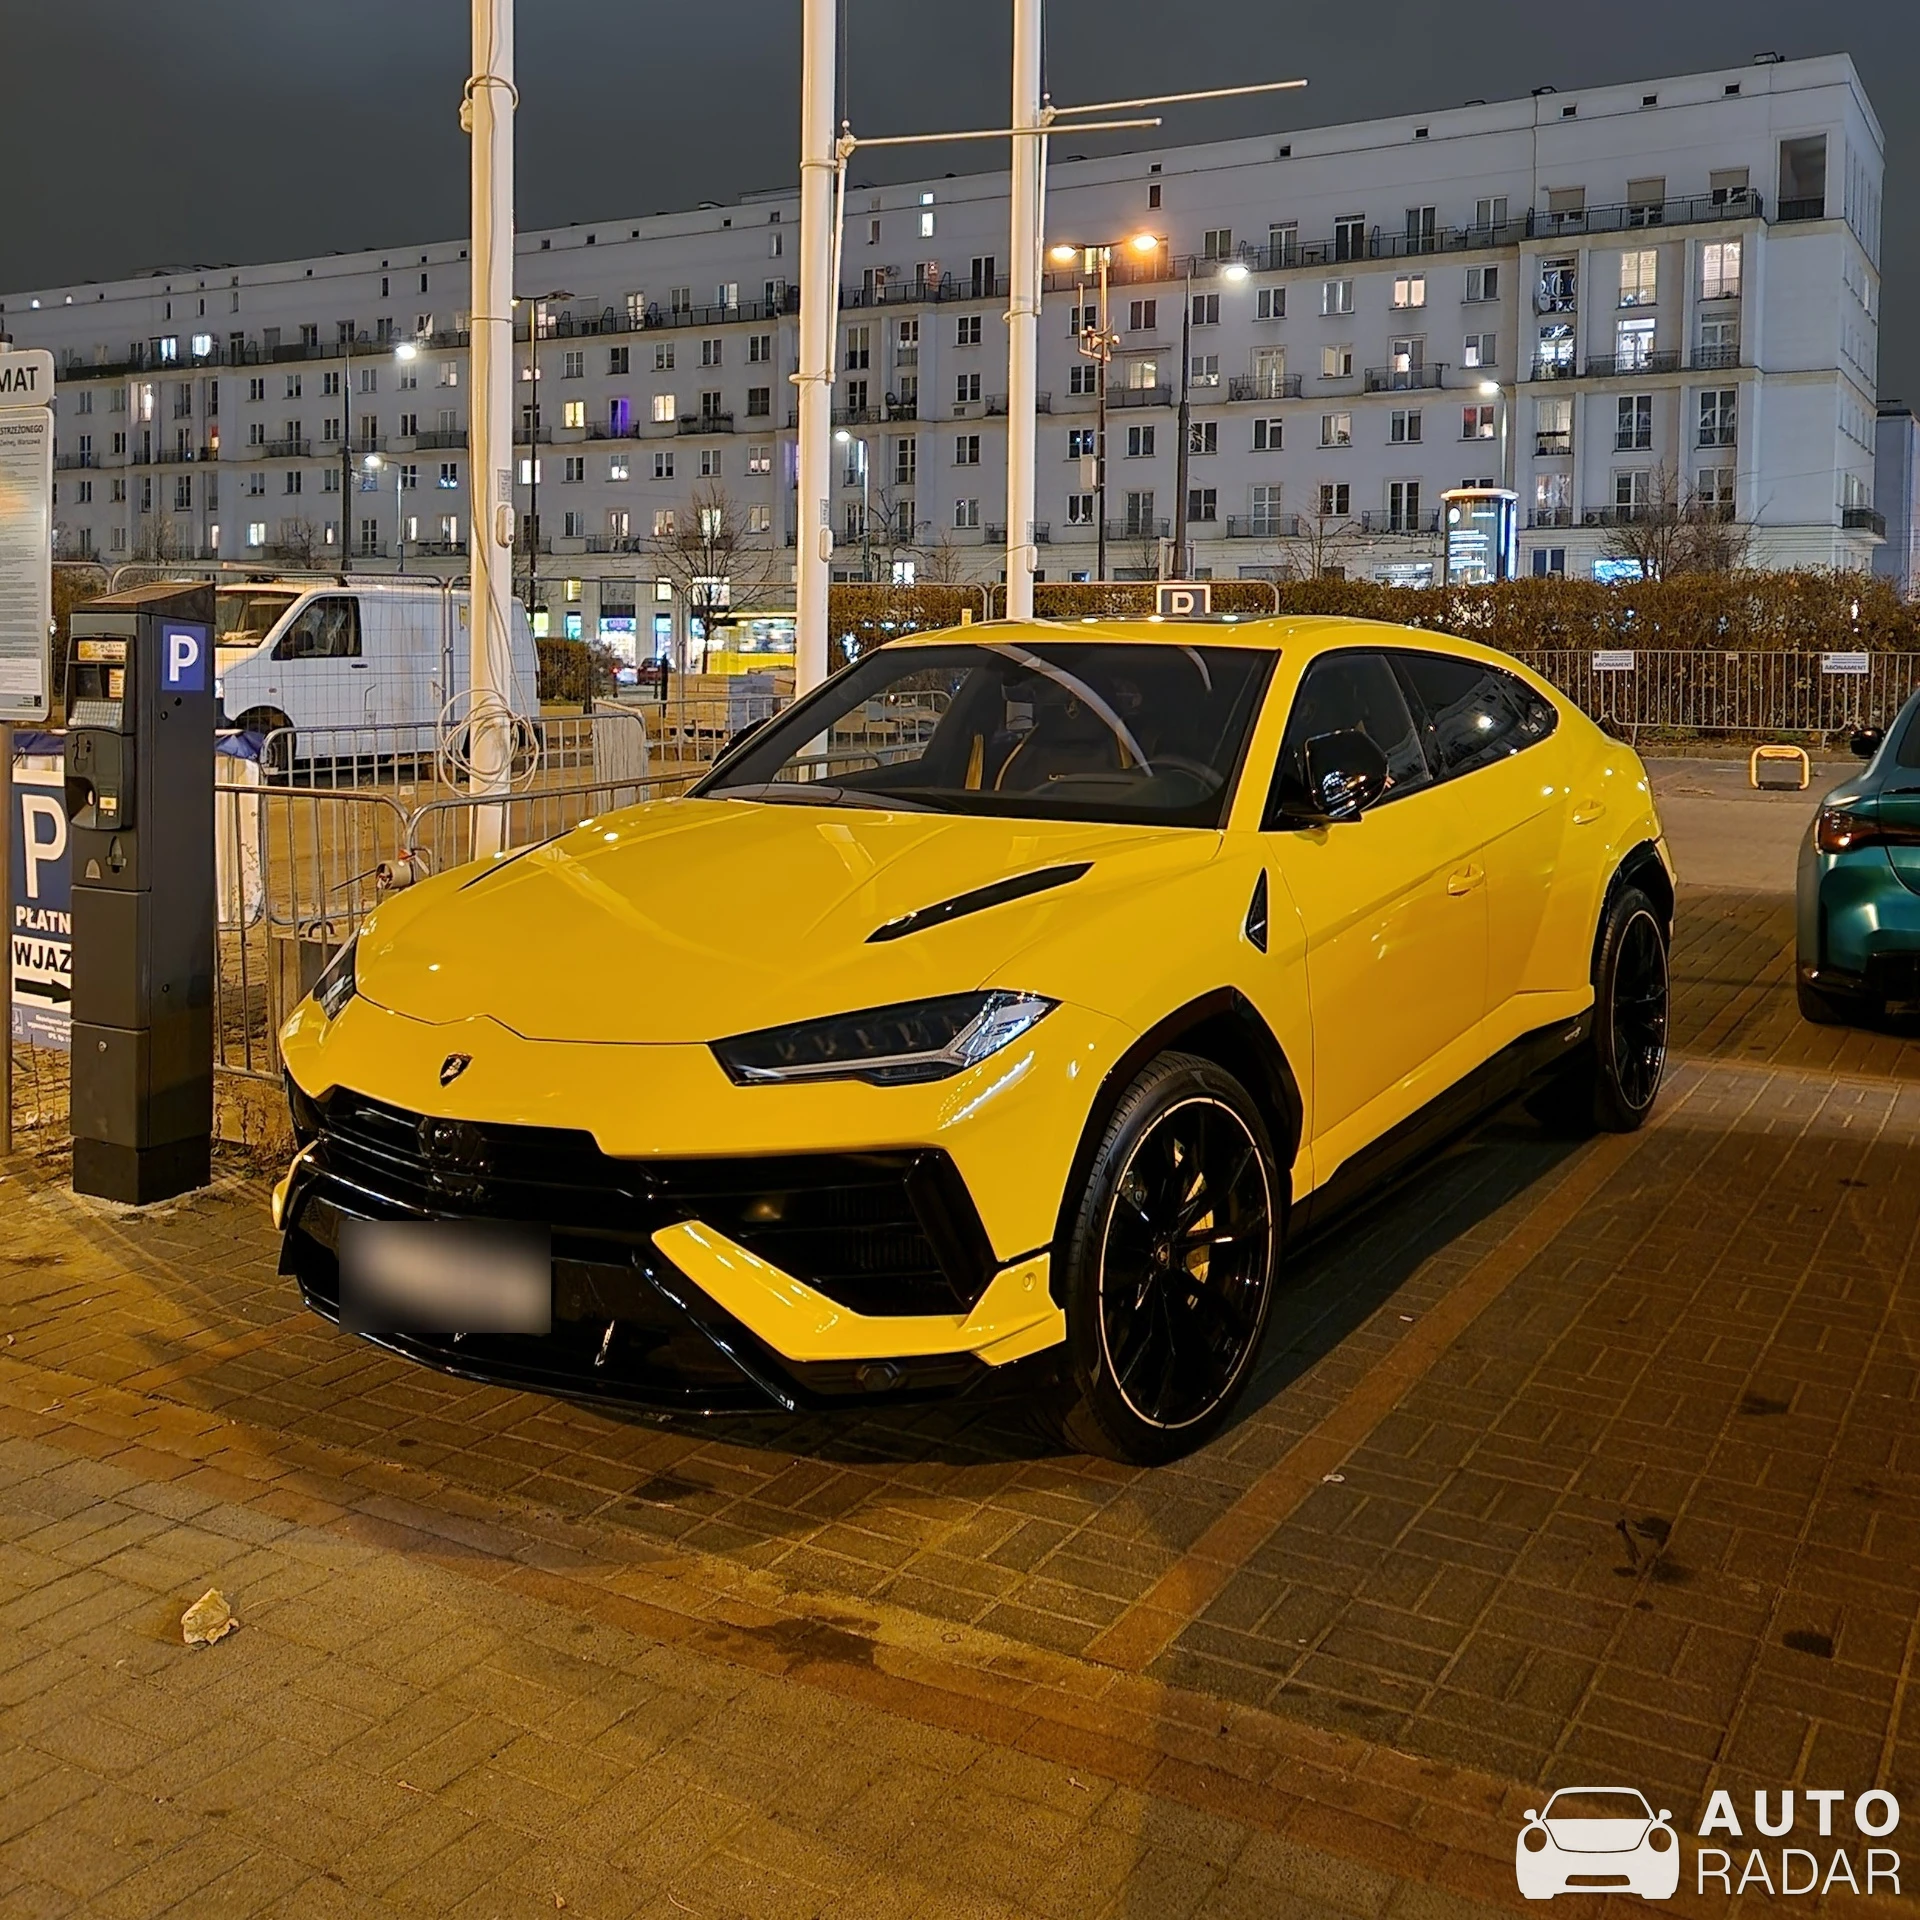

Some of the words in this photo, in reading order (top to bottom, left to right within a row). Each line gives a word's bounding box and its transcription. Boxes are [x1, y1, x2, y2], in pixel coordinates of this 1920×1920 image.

[0, 366, 38, 392] MAT
[169, 634, 199, 682] P
[21, 793, 67, 899] P
[15, 904, 72, 935] PŁATN
[14, 940, 72, 974] WJAZ
